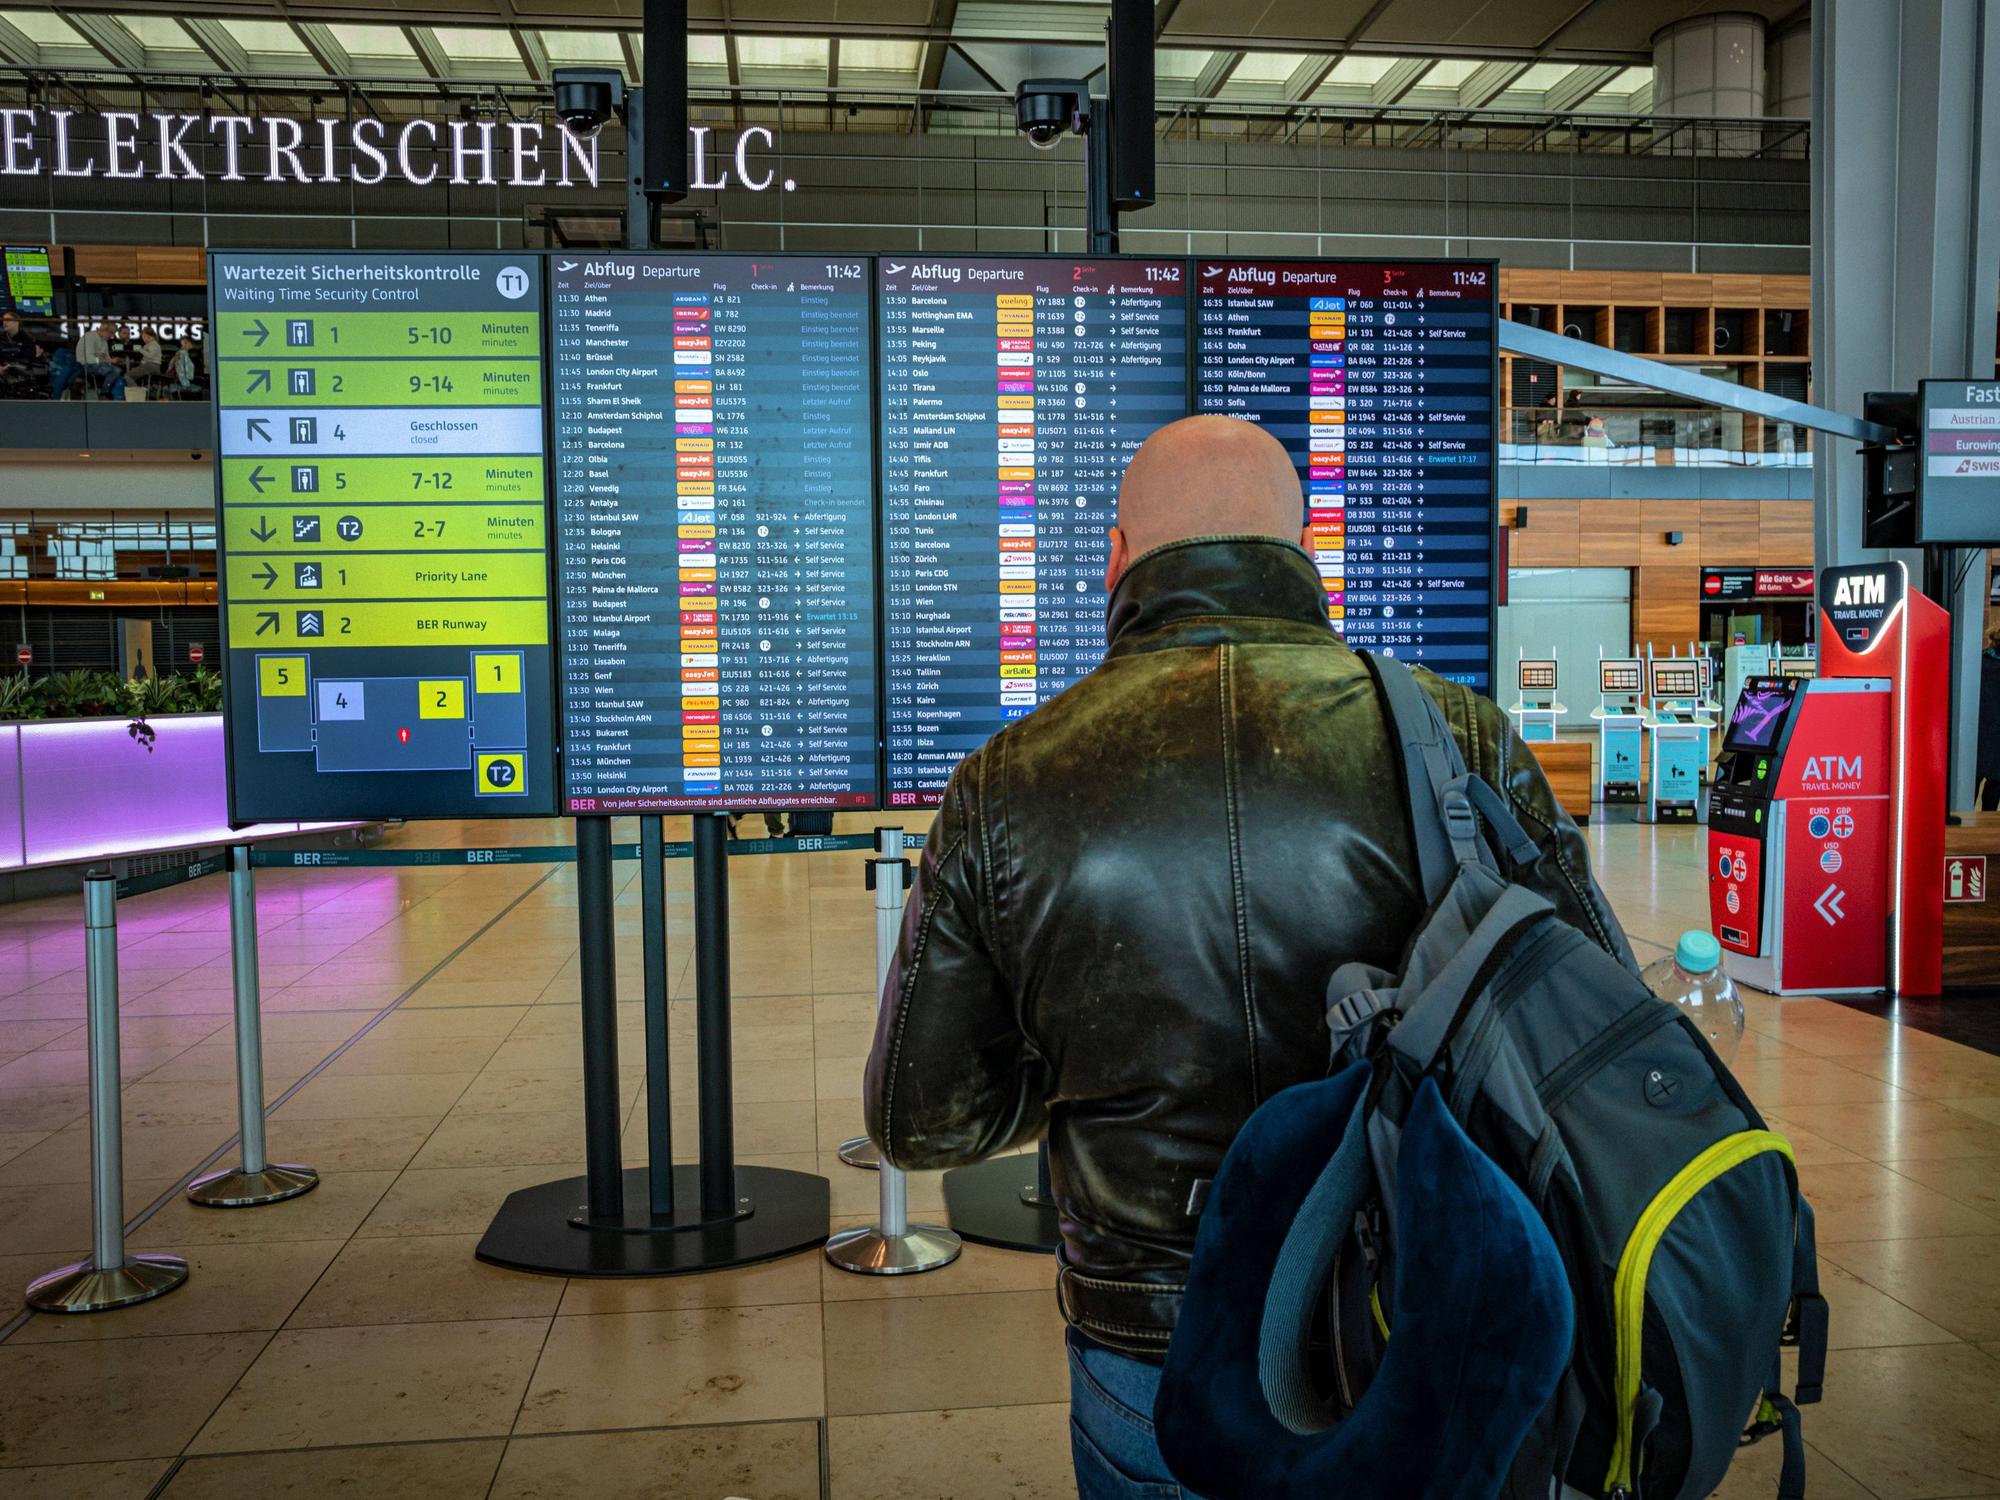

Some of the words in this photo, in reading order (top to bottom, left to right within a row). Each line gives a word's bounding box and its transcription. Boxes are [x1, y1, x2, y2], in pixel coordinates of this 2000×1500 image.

[0, 108, 599, 188] ELEKTRISCHEN
[224, 266, 306, 280] Wartezeit
[311, 266, 480, 281] Sicherheitskontrolle
[584, 262, 635, 280] Abflug
[643, 266, 700, 278] Departure
[826, 265, 860, 278] 11:42
[912, 265, 961, 283] Abflug
[968, 269, 1024, 281] Departure
[1073, 267, 1081, 280] 2
[1146, 268, 1180, 281] 11:42
[1228, 268, 1276, 285] Abflug
[1282, 272, 1337, 283] Departure
[1384, 272, 1391, 283] 3
[1453, 272, 1486, 285] 11:42
[502, 275, 523, 291] T1
[584, 282, 611, 290] Ziel/über
[713, 283, 727, 291] Flug
[751, 283, 777, 291] Check-in
[800, 284, 834, 292] Bemerkung
[911, 284, 938, 292] Ziel/über
[1037, 286, 1049, 294] Flug
[1073, 286, 1098, 294] Check-in
[1120, 286, 1153, 295] Bemerkung
[224, 288, 275, 303] Waiting
[279, 288, 311, 300] Time
[315, 288, 368, 303] Security
[372, 288, 419, 300] Control
[1227, 287, 1253, 295] Ziel/über
[1348, 289, 1361, 297] Flug
[1429, 290, 1461, 298] Bemerkung
[559, 295, 579, 303] 11:30
[584, 295, 607, 303] Athen
[714, 296, 723, 304] A3
[727, 296, 741, 304] 821
[801, 296, 828, 305] Einstieg
[886, 297, 906, 305] 13:50
[912, 297, 947, 306] Barcelona
[1000, 297, 1028, 307] vueling
[1037, 298, 1046, 306] VY
[1048, 298, 1065, 306] 1883
[1121, 298, 1161, 308] Abfertigung
[331, 327, 338, 343] 1
[408, 327, 452, 344] 5-10
[482, 324, 529, 334] Minuten
[482, 339, 517, 347] minutes
[1203, 342, 1223, 350] 16:45
[1228, 342, 1246, 350] Doha
[1348, 343, 1359, 352] QR
[1361, 343, 1375, 351] 082
[1383, 343, 1412, 351] 114-126
[332, 376, 343, 392] 2
[410, 376, 453, 393] 9-14
[483, 372, 530, 382] Minuten
[483, 387, 519, 395] minutes
[1951, 414, 1995, 425] Austrian
[334, 425, 346, 441] 4
[411, 421, 478, 431] Geschlossen
[411, 435, 438, 443] closed
[1313, 456, 1341, 464] easyJet
[1347, 455, 1376, 463] EJU5161
[1383, 455, 1412, 463] 611-616
[1428, 455, 1456, 463] Erwartet
[1458, 455, 1476, 463] 17:17
[336, 473, 346, 489] 5
[412, 473, 453, 489] 7-12
[486, 469, 533, 479] Minuten
[486, 483, 521, 491] minutes
[339, 522, 359, 535] T2
[414, 521, 445, 538] 2-7
[488, 517, 534, 527] Minuten
[487, 531, 523, 540] minutes
[565, 542, 585, 550] 12:40
[591, 542, 620, 550] Helsinki
[719, 542, 731, 550] EW
[733, 542, 751, 550] 8230
[756, 542, 787, 550] 323-326
[805, 542, 818, 550] Self
[820, 542, 844, 550] Service
[339, 569, 346, 585] 1
[416, 572, 457, 583] Priority
[462, 572, 488, 582] Lane
[1774, 575, 1793, 583] Gates
[1834, 574, 1885, 606] ATM
[1834, 611, 1858, 619] TRAVEL
[1859, 609, 1883, 619] MONEY
[340, 618, 351, 633] 2
[417, 620, 438, 629] BER
[442, 619, 487, 631] Runway
[278, 668, 288, 684] 5
[494, 666, 501, 681] 1
[568, 672, 589, 680] 13:25
[594, 672, 612, 680] Genf
[685, 671, 714, 679] easyJet
[722, 670, 752, 678] EJU5183
[759, 670, 790, 678] 611-616
[891, 669, 912, 677] 15:40
[916, 668, 941, 676] Tallinn
[1004, 667, 1032, 675] airBaltic
[1039, 667, 1048, 675] BT
[1052, 667, 1065, 675] 822
[335, 693, 348, 708] 4
[436, 691, 447, 707] 2
[490, 766, 512, 781] T2
[1802, 756, 1862, 781] ATM
[1802, 783, 1831, 791] TRAVEL
[1832, 782, 1861, 790] MONEY
[571, 799, 596, 810] BER
[618, 800, 637, 809] jeder
[638, 797, 707, 807] Sicherheitskontrolle
[708, 798, 722, 806] sind
[724, 797, 757, 806] sämtliche
[758, 796, 799, 806] Abfluggates
[801, 796, 837, 804] erreichbar.
[893, 794, 916, 804] BER
[923, 794, 937, 802] Von
[798, 838, 822, 850] BER
[294, 853, 321, 865] BER
[468, 851, 493, 863] BER
[188, 863, 201, 878] BER
